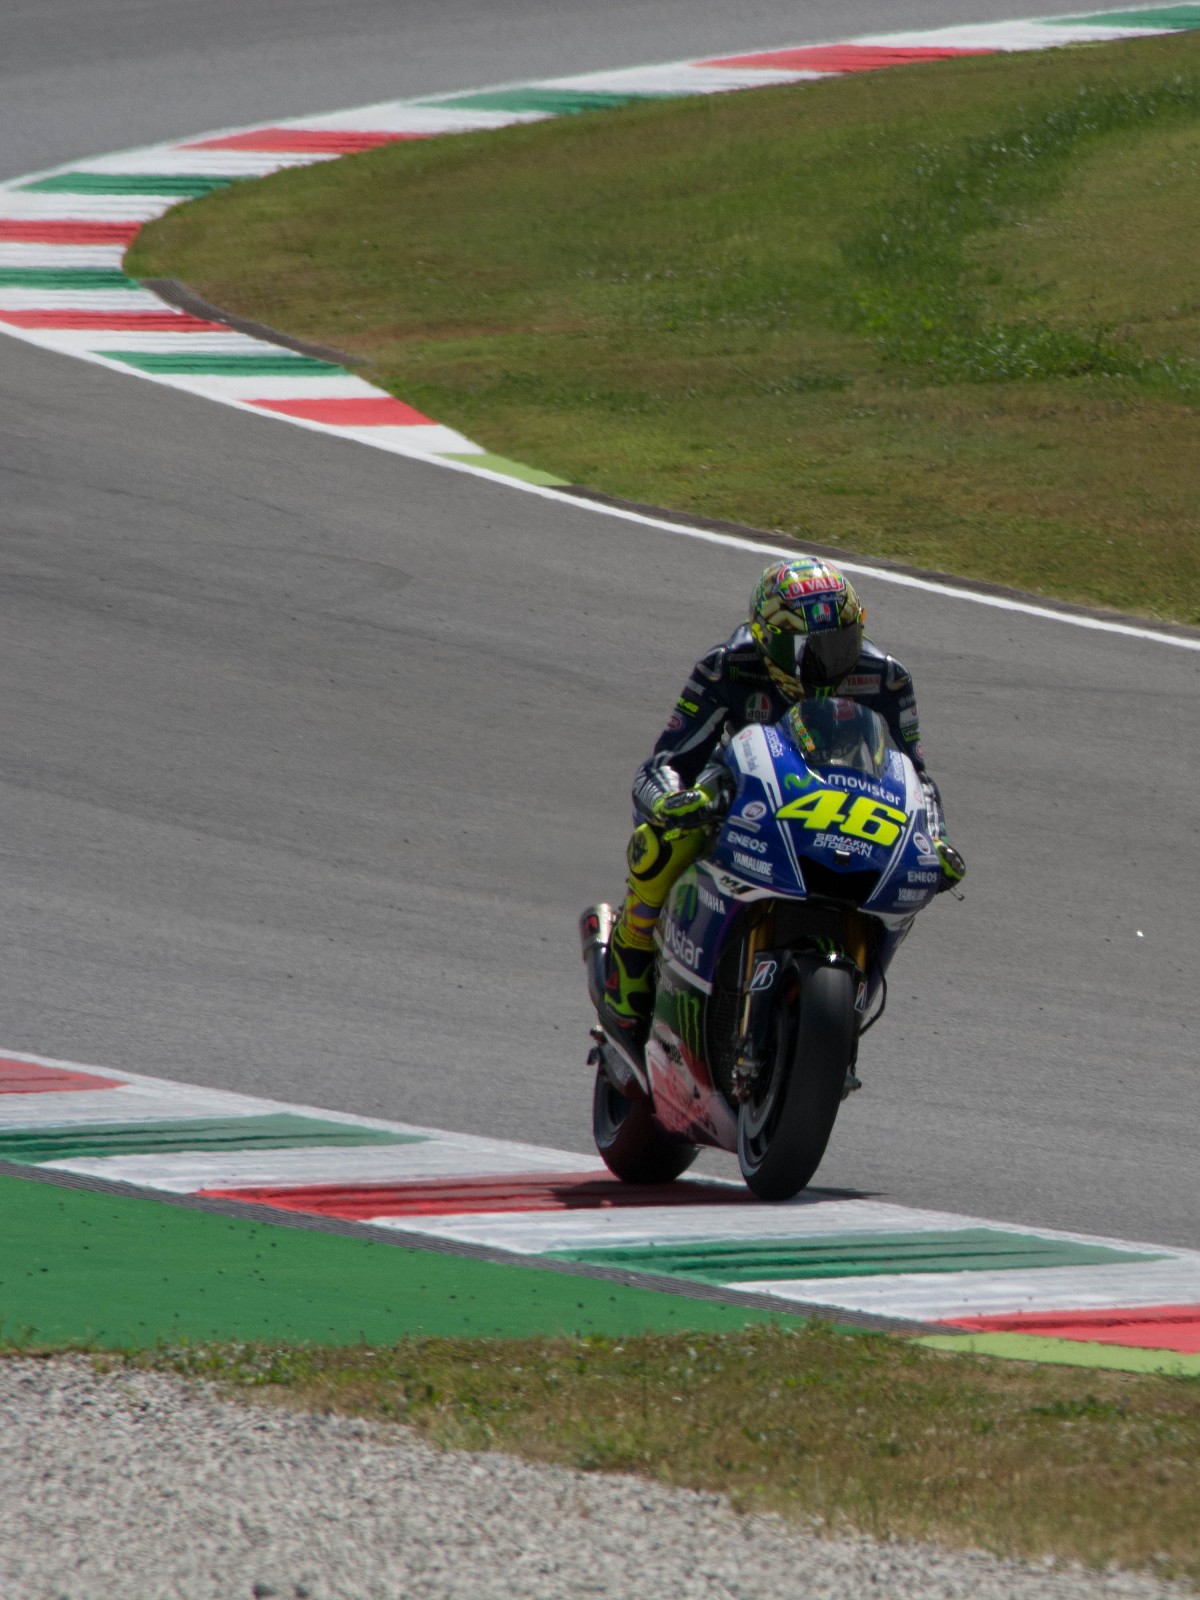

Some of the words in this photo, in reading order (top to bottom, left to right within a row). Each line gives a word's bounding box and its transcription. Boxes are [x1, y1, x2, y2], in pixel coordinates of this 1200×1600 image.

[806, 576, 837, 592] VALE
[827, 773, 901, 806] movistar
[776, 789, 908, 846] 46
[726, 831, 768, 854] ENEOS
[815, 833, 873, 852] SEMAKIN
[827, 841, 872, 858] DEPAN
[732, 850, 774, 877] YAMALUBE
[907, 870, 938, 883] ENEOS
